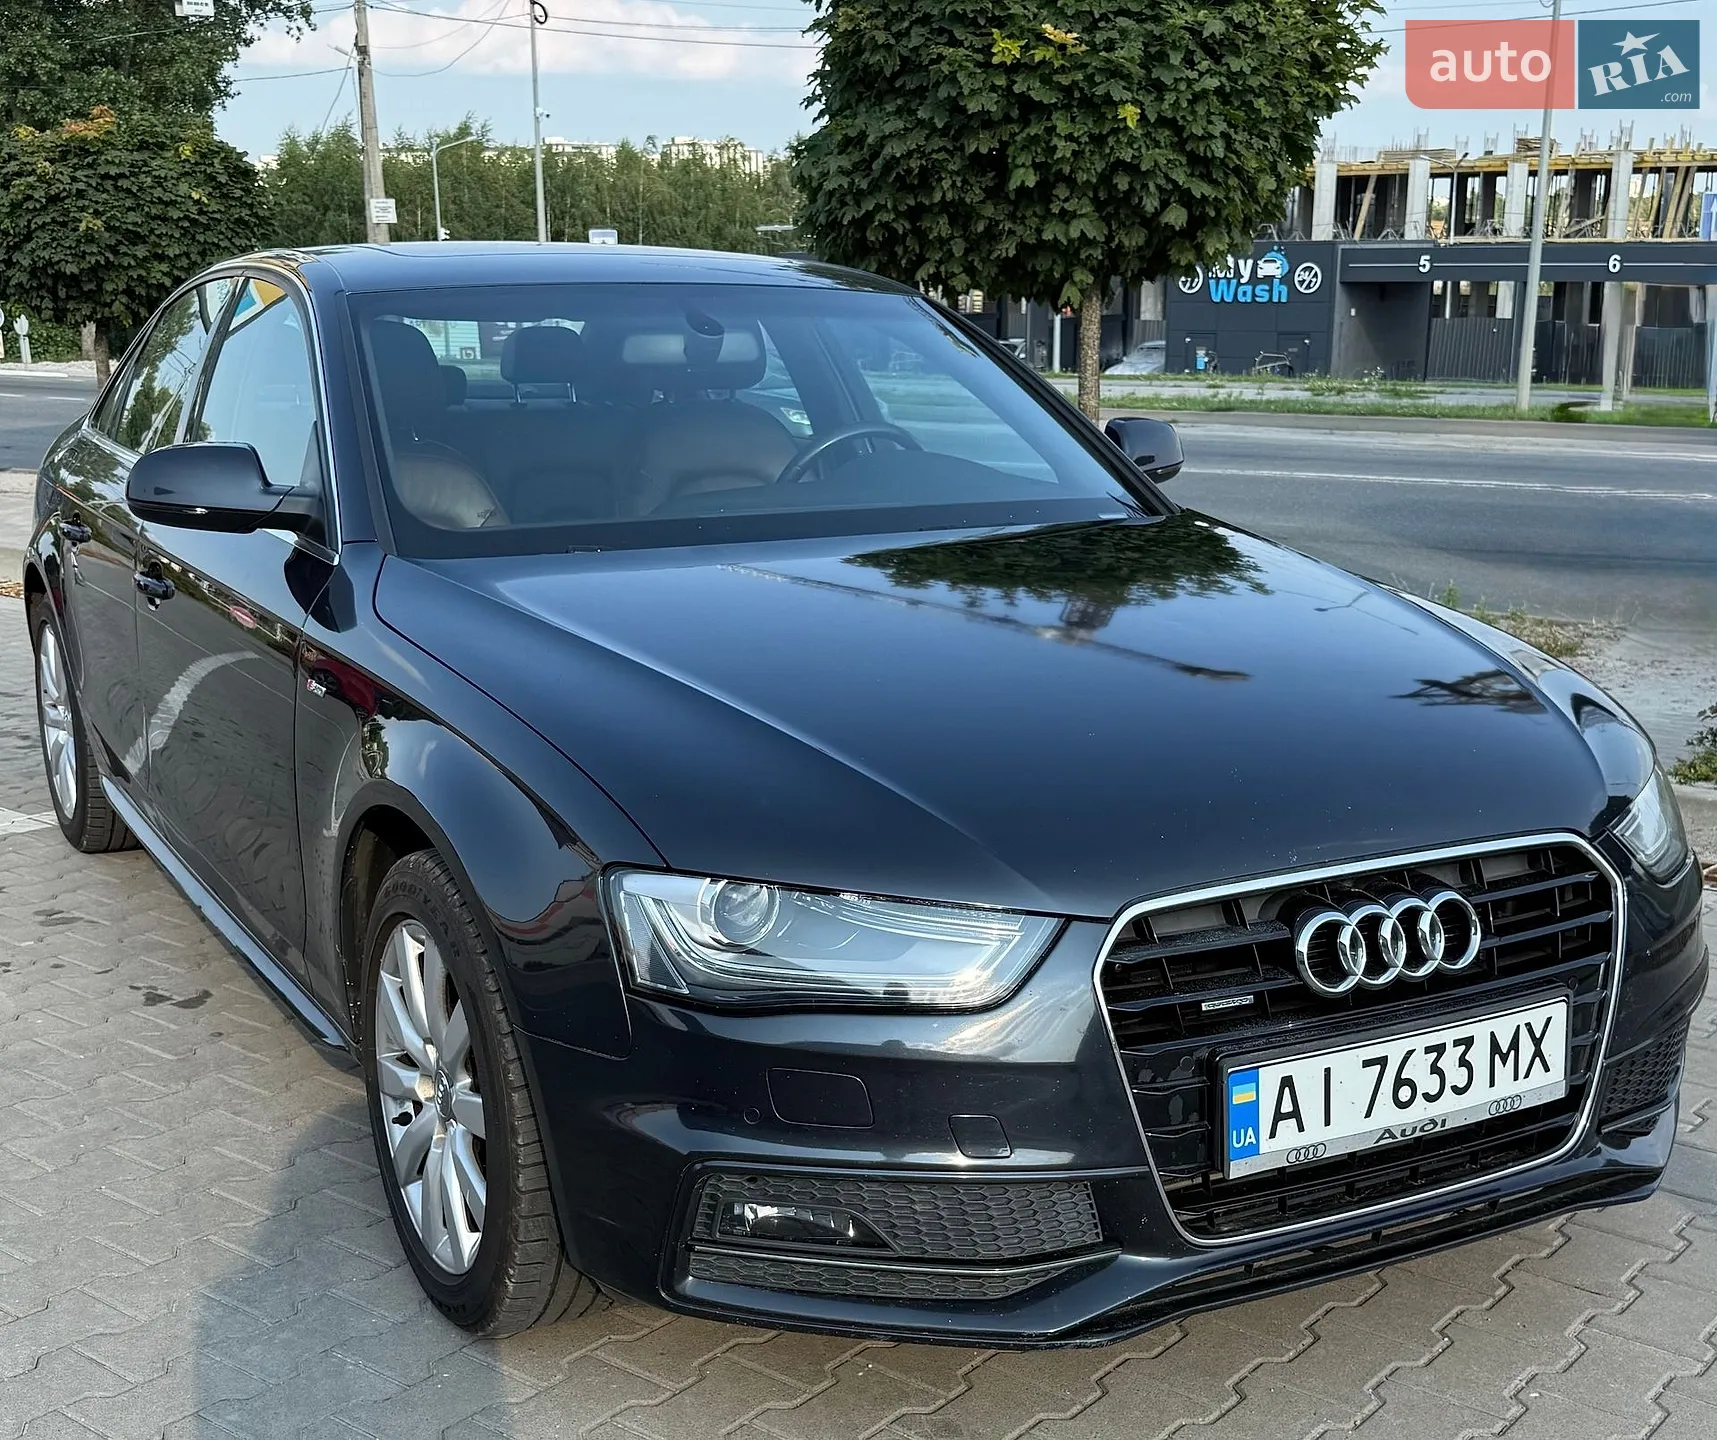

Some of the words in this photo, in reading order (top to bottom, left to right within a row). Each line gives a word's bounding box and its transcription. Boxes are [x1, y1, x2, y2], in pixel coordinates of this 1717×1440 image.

[1418, 255, 1431, 273] 5
[1608, 254, 1622, 273] 6
[1208, 278, 1288, 303] Wash
[1268, 1066, 1332, 1140] AI
[1361, 1034, 1475, 1120] 7633
[1488, 1016, 1553, 1088] MX
[1232, 1126, 1257, 1148] UA
[1373, 1117, 1447, 1145] Audi
